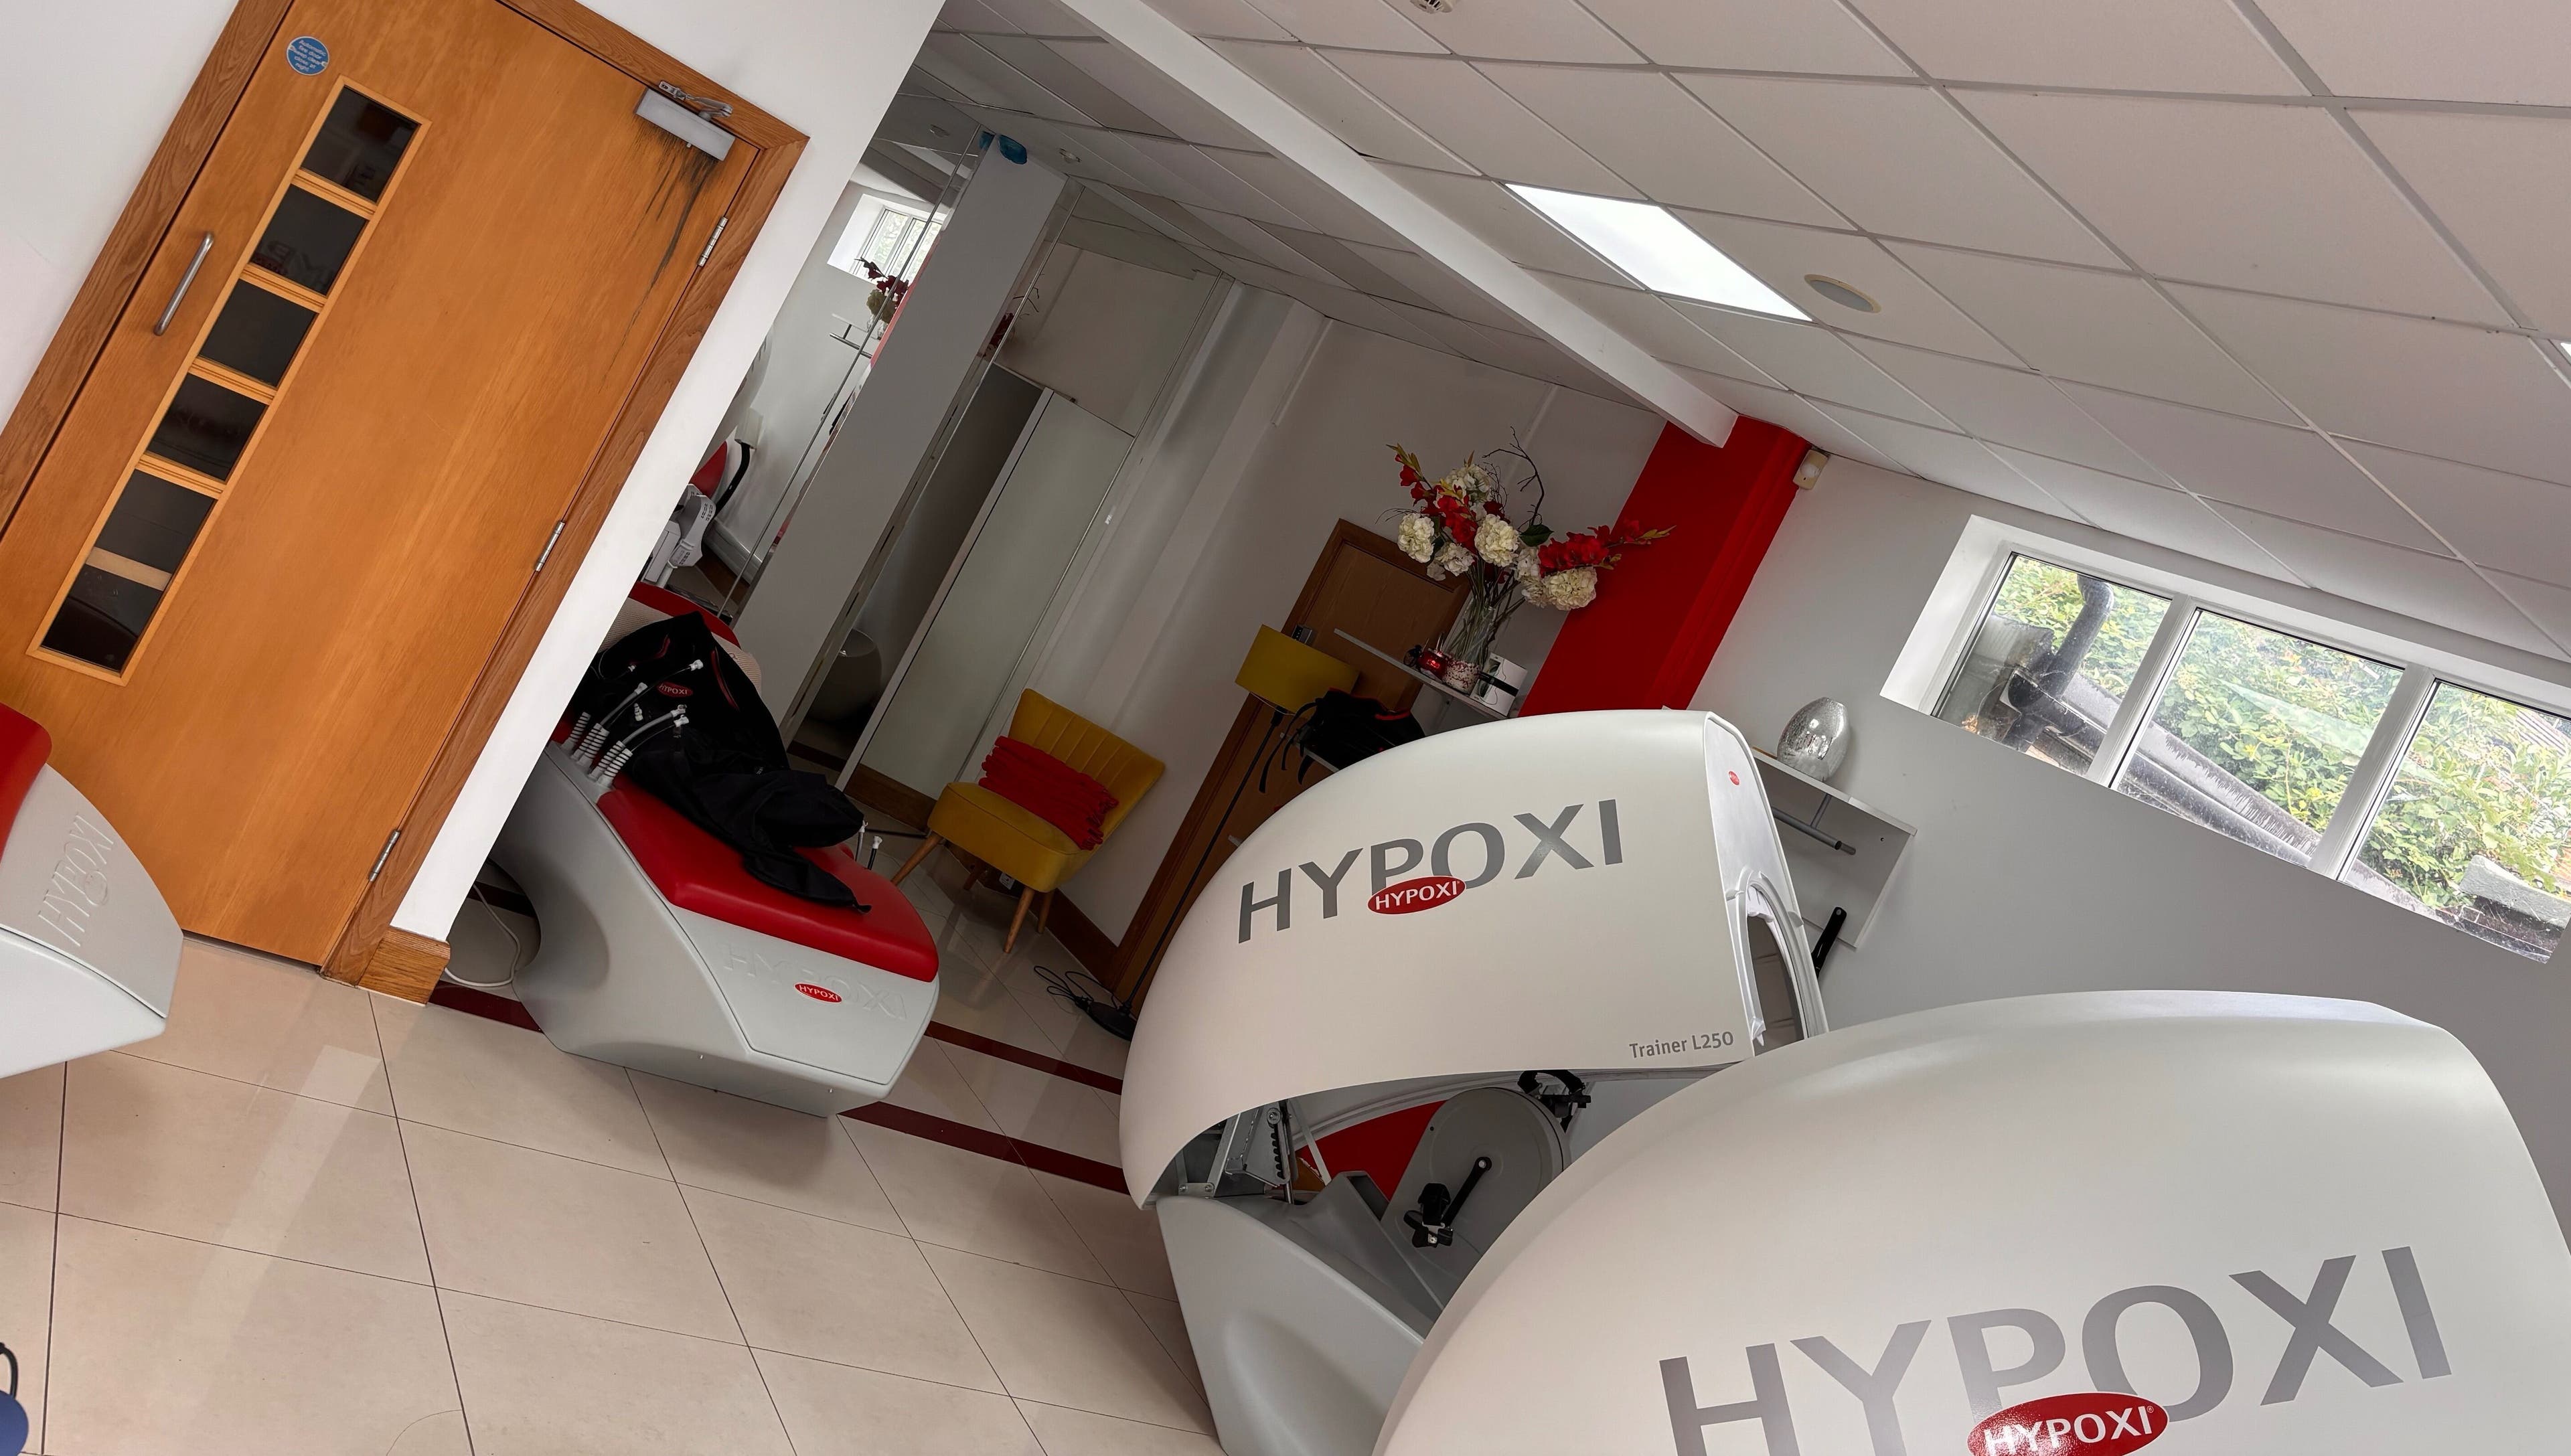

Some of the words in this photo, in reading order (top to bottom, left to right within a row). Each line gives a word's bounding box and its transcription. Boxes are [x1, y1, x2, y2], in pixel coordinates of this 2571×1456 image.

[659, 683, 688, 695] HYPOXI
[38, 812, 114, 947] HYPOXI
[1239, 799, 1623, 944] HYPOXI
[799, 985, 839, 1001] HYPOXI
[1629, 1039, 1687, 1058] Trainer
[1692, 1031, 1734, 1050] L250
[1659, 1246, 2452, 1456] HYPOXI
